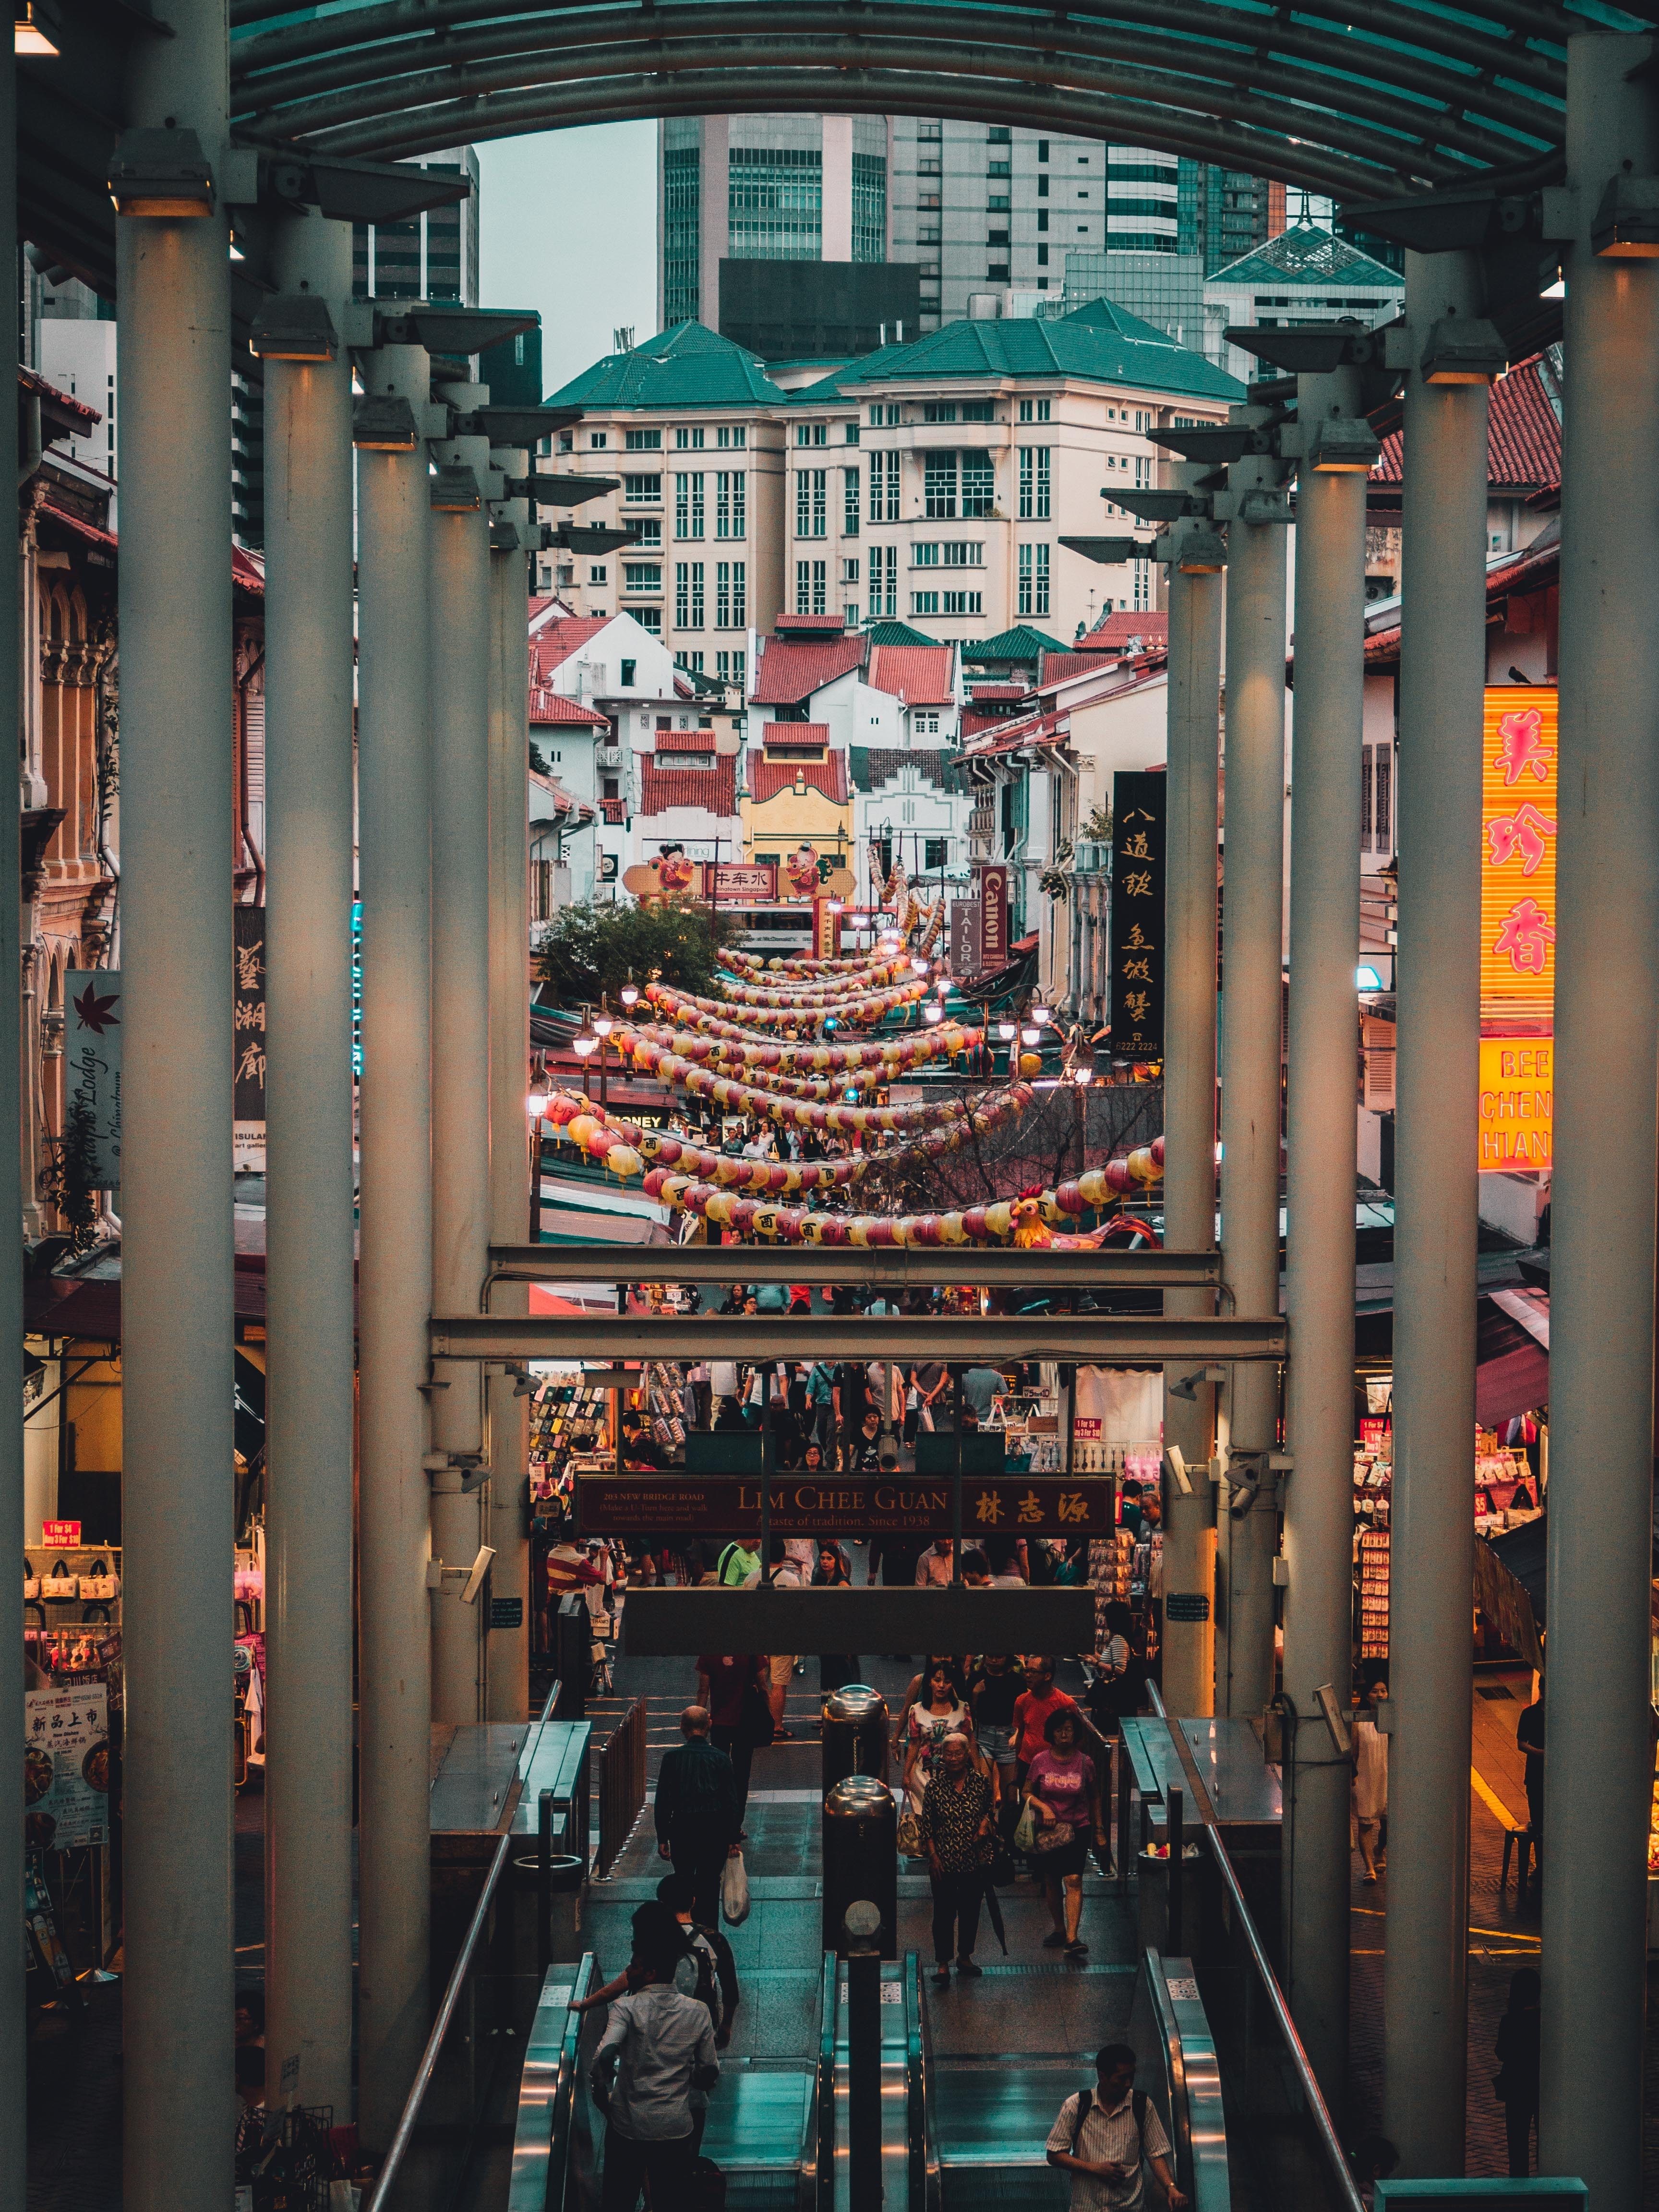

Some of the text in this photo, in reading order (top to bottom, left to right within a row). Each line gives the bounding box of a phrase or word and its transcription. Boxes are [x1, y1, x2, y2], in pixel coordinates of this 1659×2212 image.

[716, 872, 768, 886] 牛车水
[986, 872, 1002, 949] Canon
[961, 908, 972, 962] TAILOR
[70, 1047, 108, 1104] Lodge
[1502, 1051, 1549, 1077] BEE
[1481, 1092, 1551, 1118] CHEN
[1484, 1132, 1548, 1158] HIAN
[769, 1516, 794, 1526] taste
[797, 1514, 809, 1526] of
[868, 1515, 898, 1526] Since
[902, 1515, 930, 1526] 1938
[976, 1490, 1090, 1525] 林志源
[49, 1524, 53, 1533] 1
[54, 1524, 63, 1533] For
[54, 1535, 59, 1544] 3
[59, 1535, 68, 1544] For
[32, 1708, 97, 1732] 新品上市
